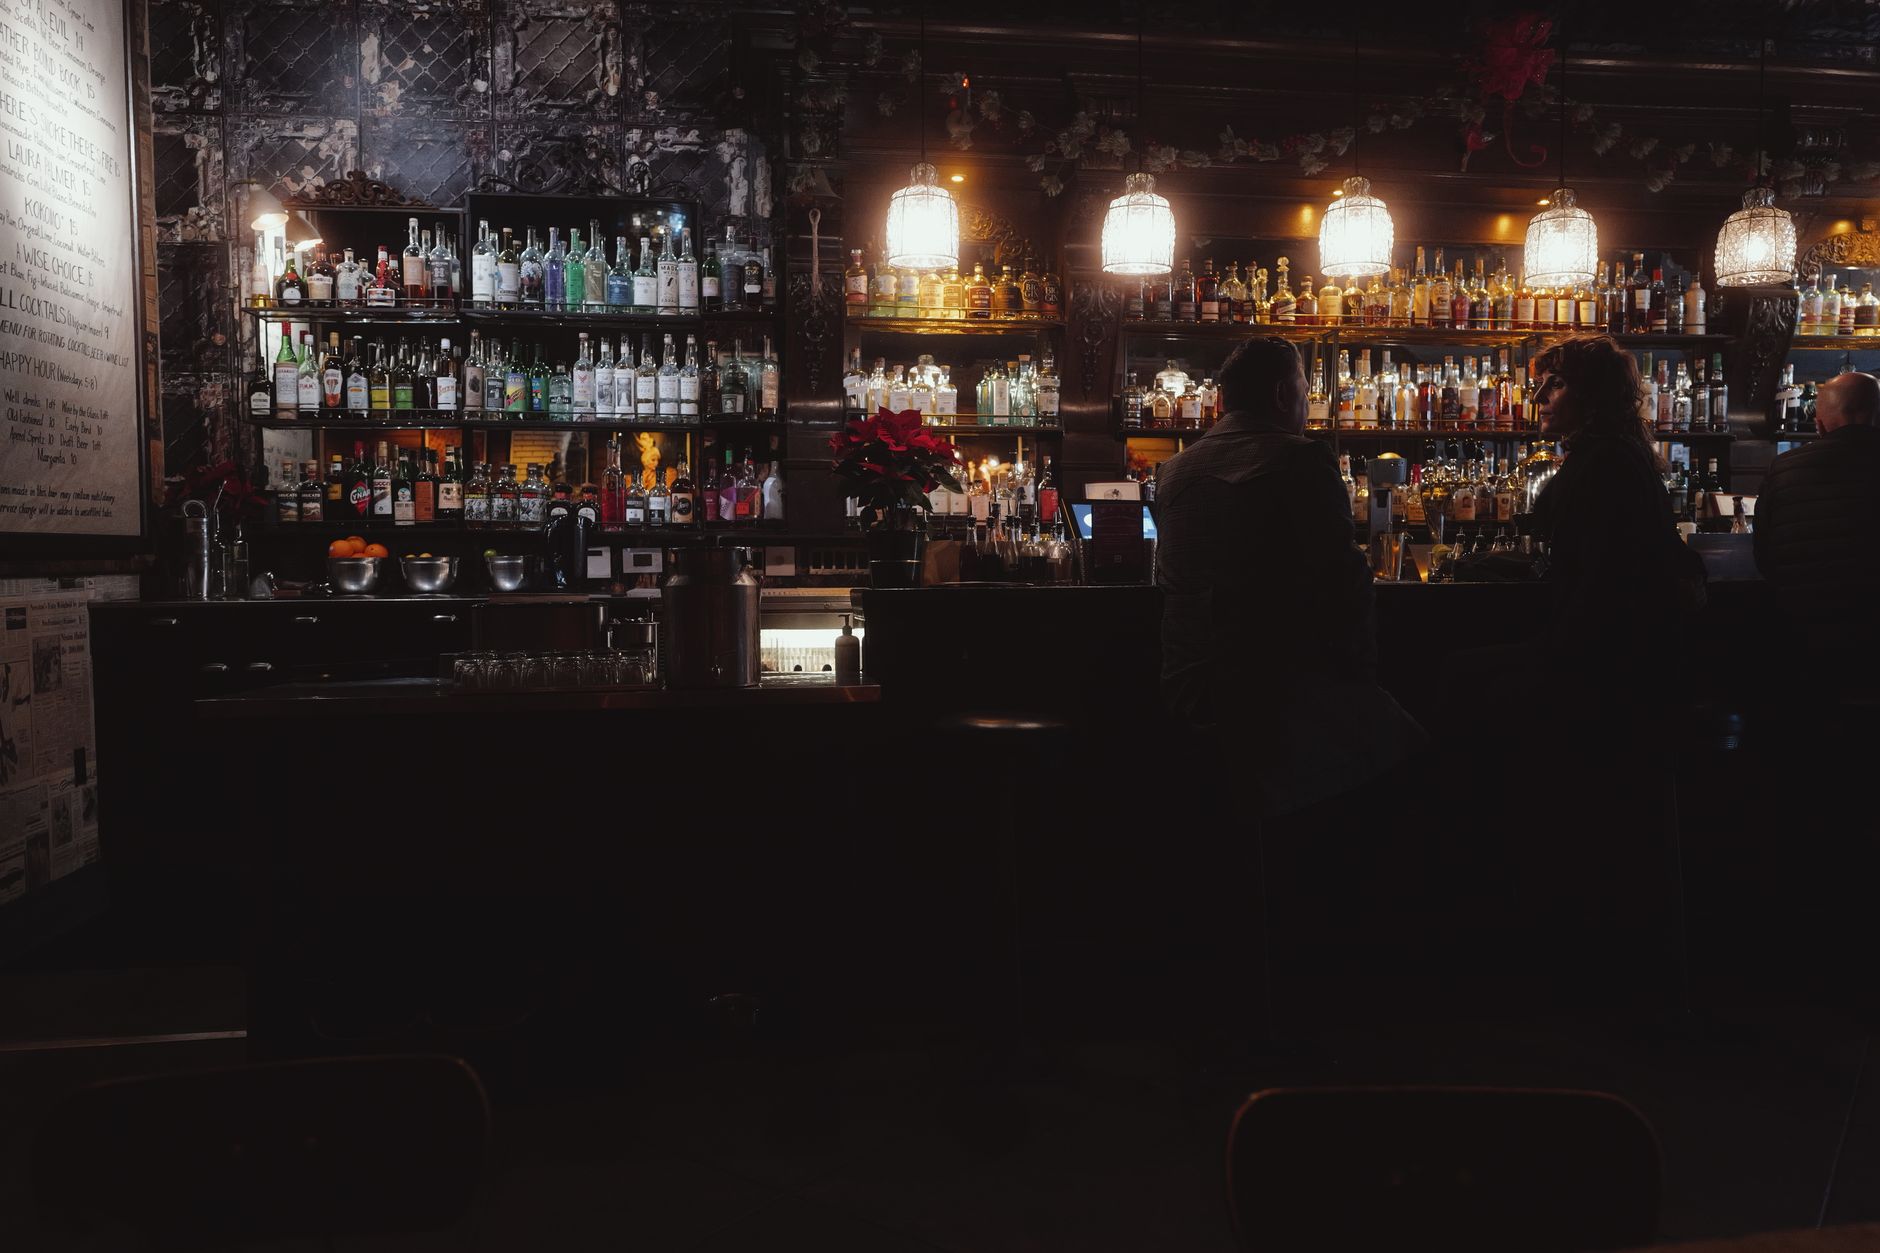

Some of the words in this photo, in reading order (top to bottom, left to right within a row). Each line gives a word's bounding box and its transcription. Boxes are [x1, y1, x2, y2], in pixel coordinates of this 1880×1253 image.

[50, 11, 69, 41] EVIL
[87, 83, 95, 99] 15
[8, 139, 41, 171] LAURA
[83, 179, 92, 196] 15
[70, 218, 78, 236] 15
[16, 242, 22, 261] A
[23, 244, 49, 272] WISE
[52, 257, 85, 285] CHOICE
[20, 293, 66, 325] COCKTAILS
[105, 326, 109, 340] 9
[23, 325, 37, 341] FOR
[0, 350, 31, 375] HAPPY
[34, 357, 56, 381] HOUR
[4, 388, 20, 404] Well
[23, 392, 41, 408] drinks
[62, 400, 72, 415] Wine
[7, 407, 18, 421] Old
[20, 408, 44, 426] Fashioned
[49, 416, 55, 428] 10
[48, 433, 54, 445] 10
[37, 447, 65, 470] Margarita
[71, 452, 77, 465] 10
[37, 484, 47, 497] this
[48, 485, 57, 498] bar
[60, 491, 71, 503] may
[18, 503, 36, 520] charge
[39, 503, 49, 515] will
[50, 504, 55, 515] be
[57, 506, 72, 516] added
